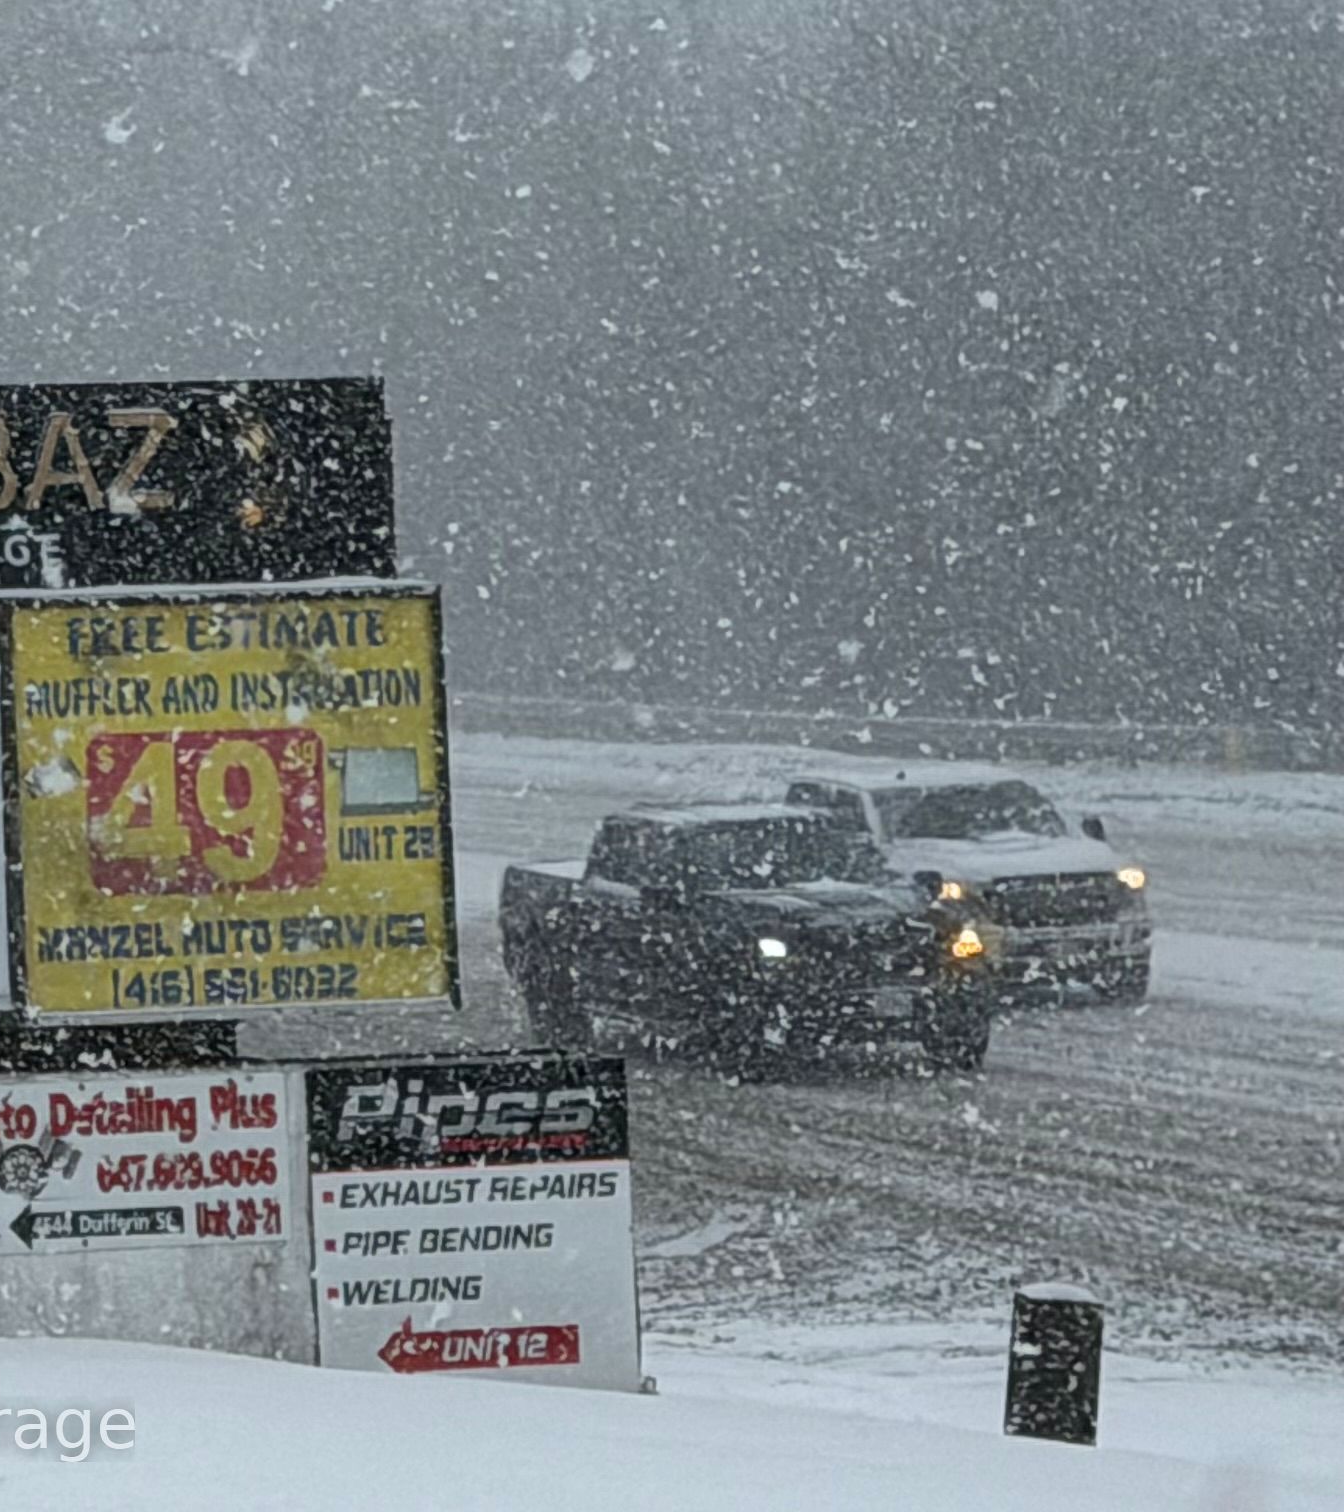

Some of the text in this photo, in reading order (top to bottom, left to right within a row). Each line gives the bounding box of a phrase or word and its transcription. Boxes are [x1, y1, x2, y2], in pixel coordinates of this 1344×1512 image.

[67, 609, 386, 657] FREE ESTIMATE
[25, 676, 153, 719] MUFFLER
[162, 672, 218, 713] AND
[98, 740, 283, 883] 49
[339, 825, 397, 861] UNIT
[183, 918, 271, 956] AUTO
[280, 913, 426, 951] SERVICE
[48, 1088, 197, 1144] Detailing
[209, 1080, 278, 1130] Plus
[339, 1172, 619, 1209] EXHAUST REPAIRS
[79, 1209, 150, 1236] Dufferin
[342, 1223, 554, 1256] PIPE BENDING
[343, 1276, 482, 1307] WELDING
[518, 1333, 549, 1359] 12
